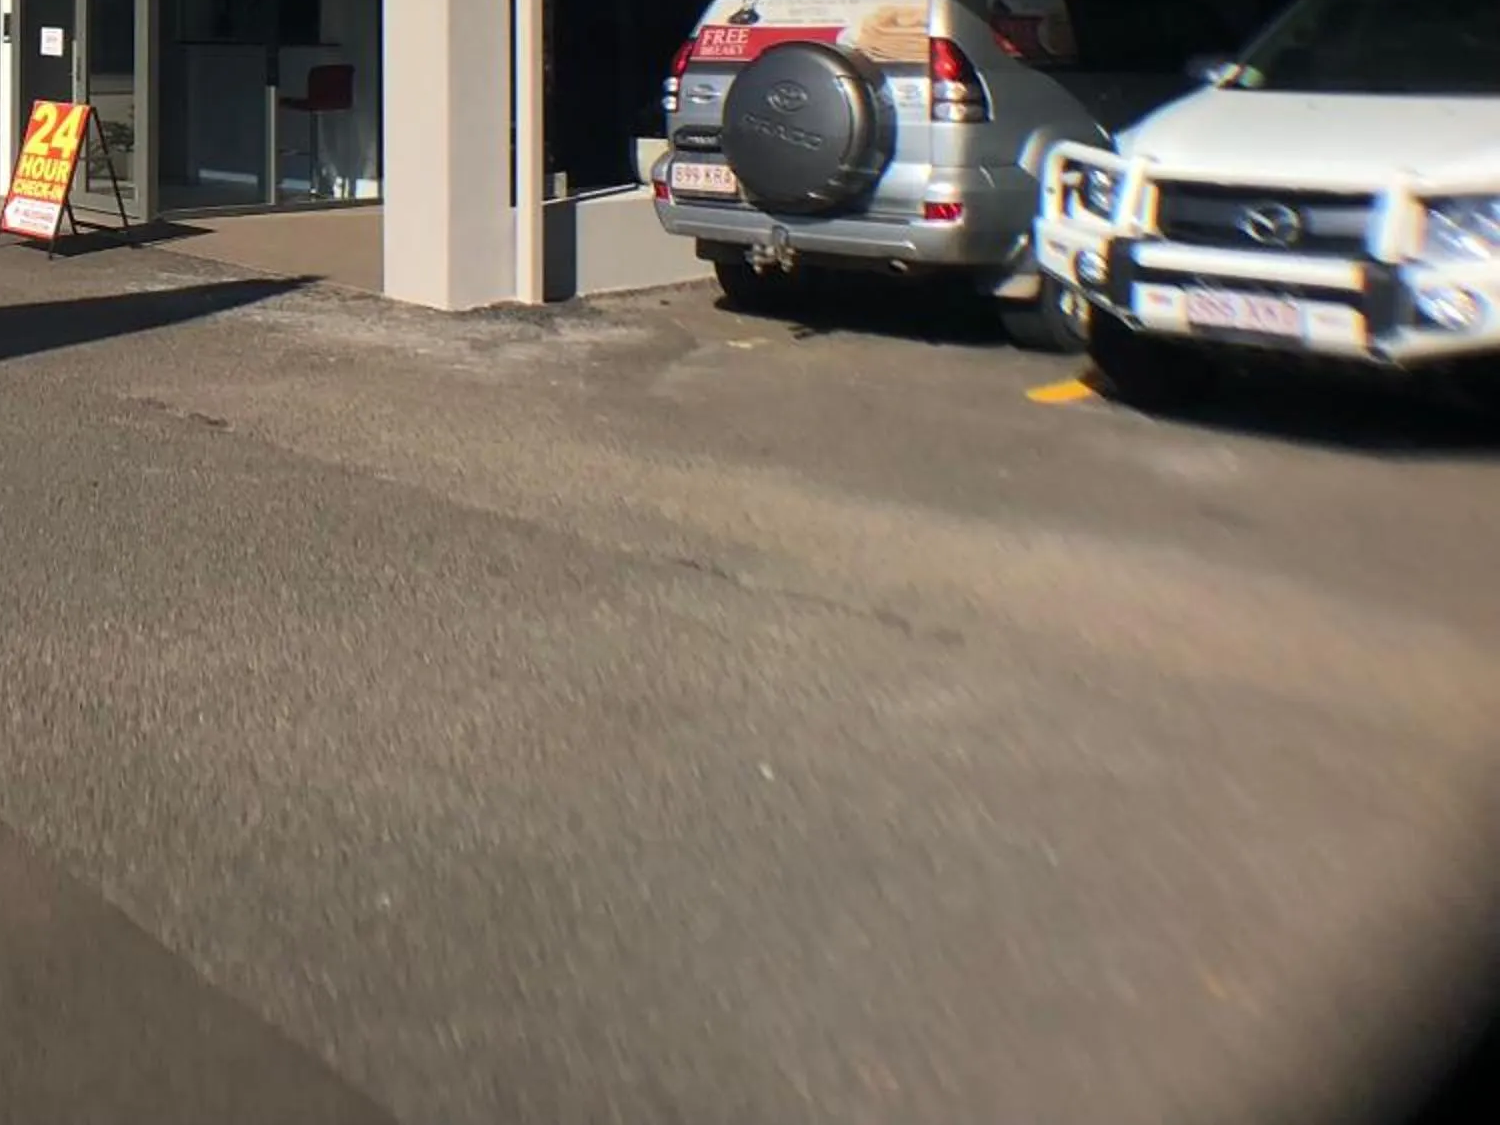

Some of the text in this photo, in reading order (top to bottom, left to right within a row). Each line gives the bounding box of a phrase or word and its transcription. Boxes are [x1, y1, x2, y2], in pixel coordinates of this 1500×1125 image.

[702, 28, 749, 45] FREE
[23, 103, 84, 159] 24
[742, 113, 822, 151] PRADO
[20, 154, 70, 183] HOUR
